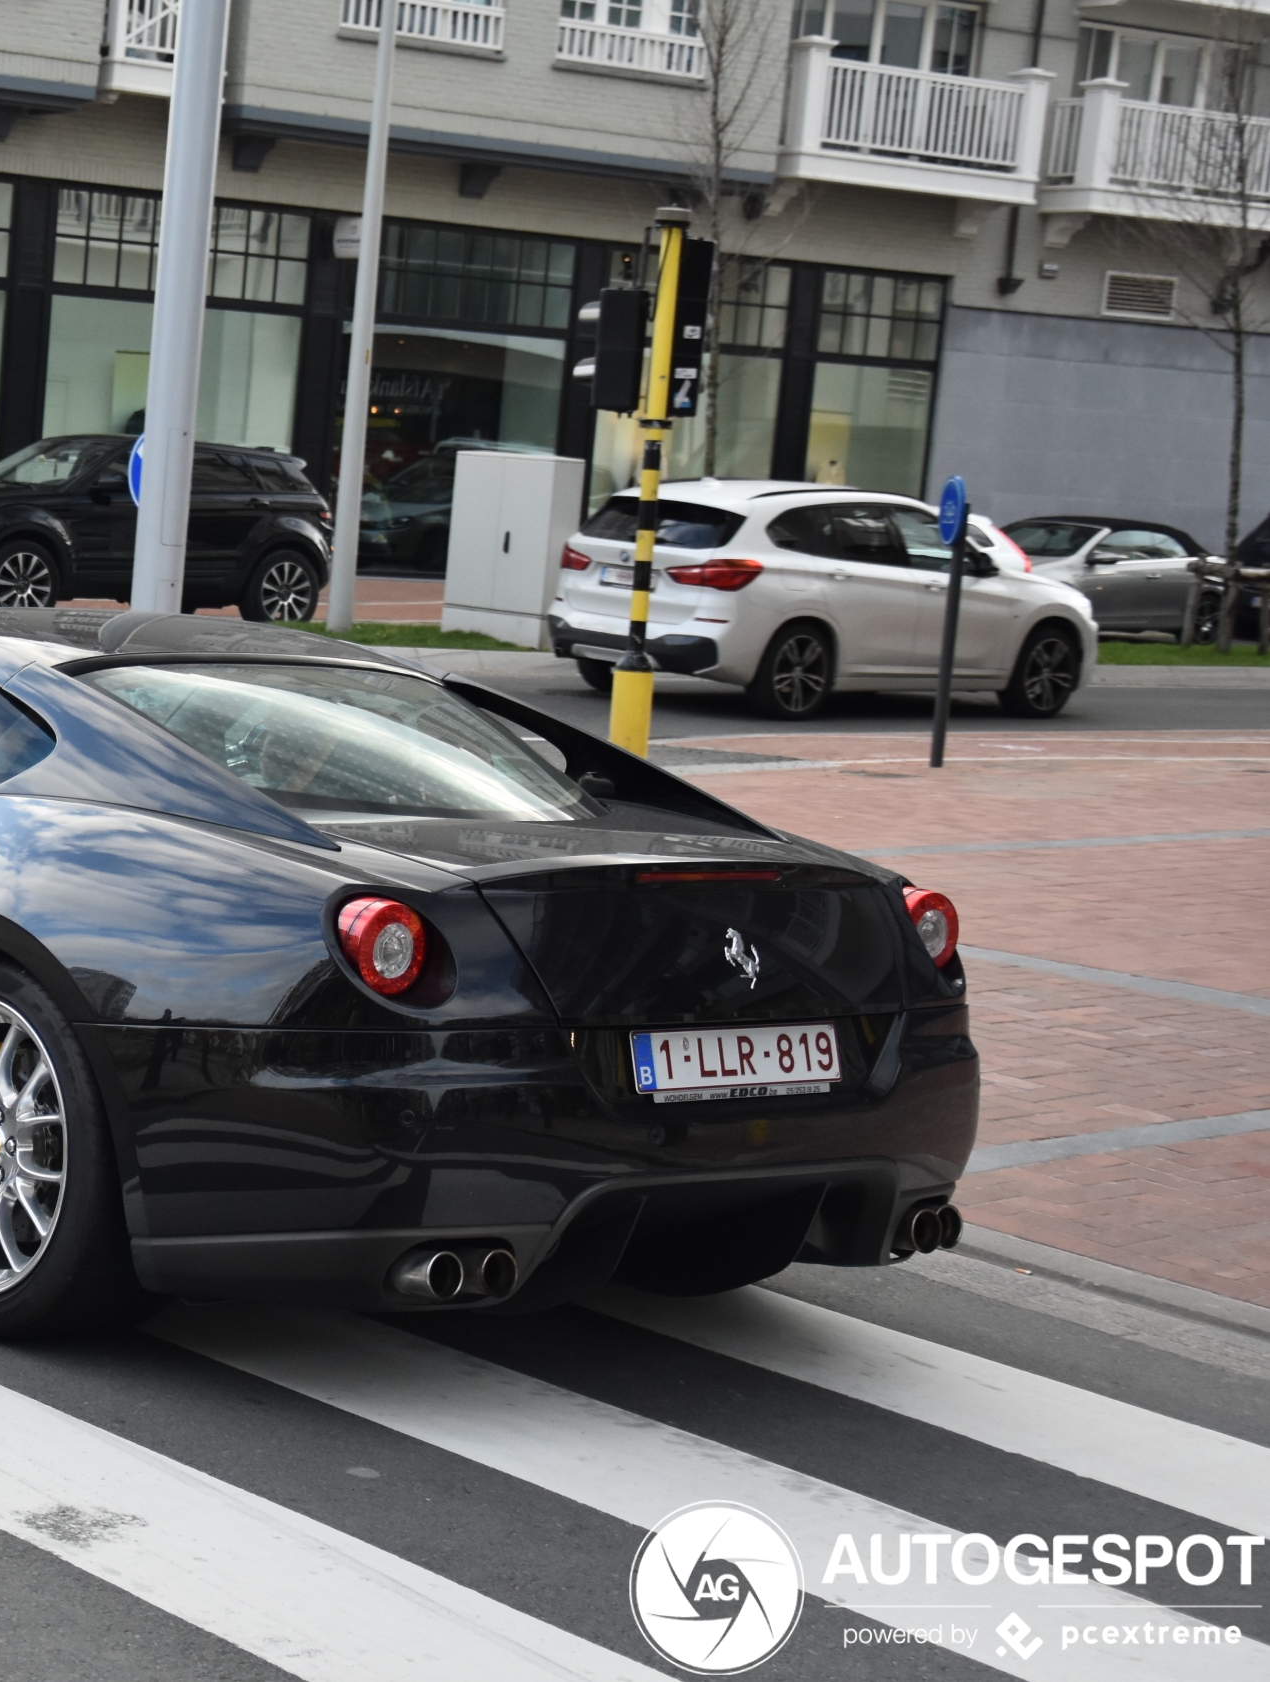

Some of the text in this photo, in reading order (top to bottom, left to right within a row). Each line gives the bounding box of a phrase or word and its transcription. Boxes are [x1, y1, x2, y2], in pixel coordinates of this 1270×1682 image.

[660, 1031, 833, 1080] 1-LLR-819
[640, 1066, 653, 1085] B
[664, 1093, 703, 1102] WONDELGEM
